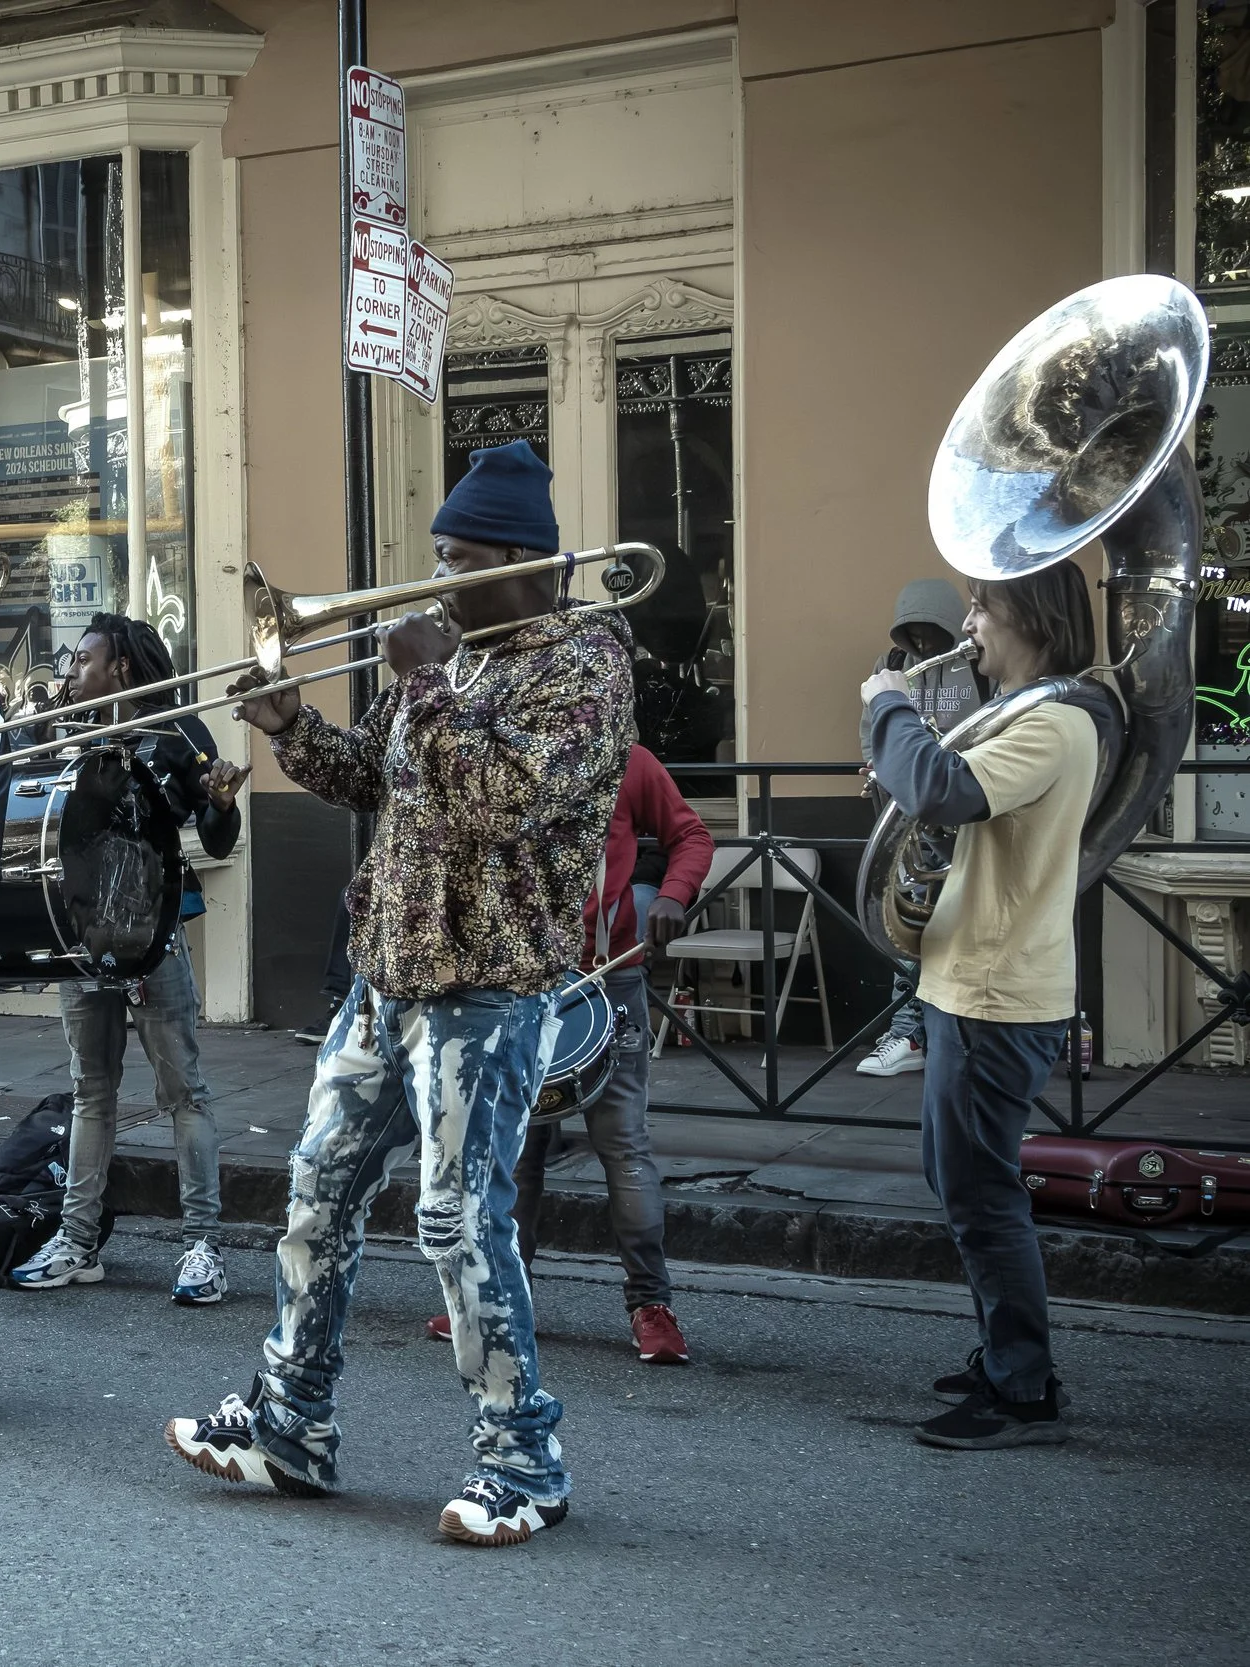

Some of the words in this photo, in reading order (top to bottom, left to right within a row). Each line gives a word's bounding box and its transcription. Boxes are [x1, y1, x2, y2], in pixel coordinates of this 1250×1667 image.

[351, 79, 369, 109] NO
[370, 88, 402, 116] STOPPING
[361, 140, 400, 164] THURSDAY
[366, 157, 395, 178] STREET
[360, 171, 400, 194] CLEANING
[353, 230, 369, 261] NO
[370, 239, 406, 266] STOPPING
[373, 277, 386, 295] TO
[408, 251, 423, 283] NO
[421, 264, 450, 301] PARKING
[356, 295, 400, 321] CORNER
[407, 293, 443, 333] FREIGHT
[408, 318, 434, 350] ZONE
[351, 341, 400, 366] ANYTIME
[13, 443, 53, 459] ORLEANS
[5, 462, 27, 475] 2024
[28, 457, 73, 473] SCHEDULE
[607, 573, 631, 589] KING
[1200, 566, 1226, 579] IT'S
